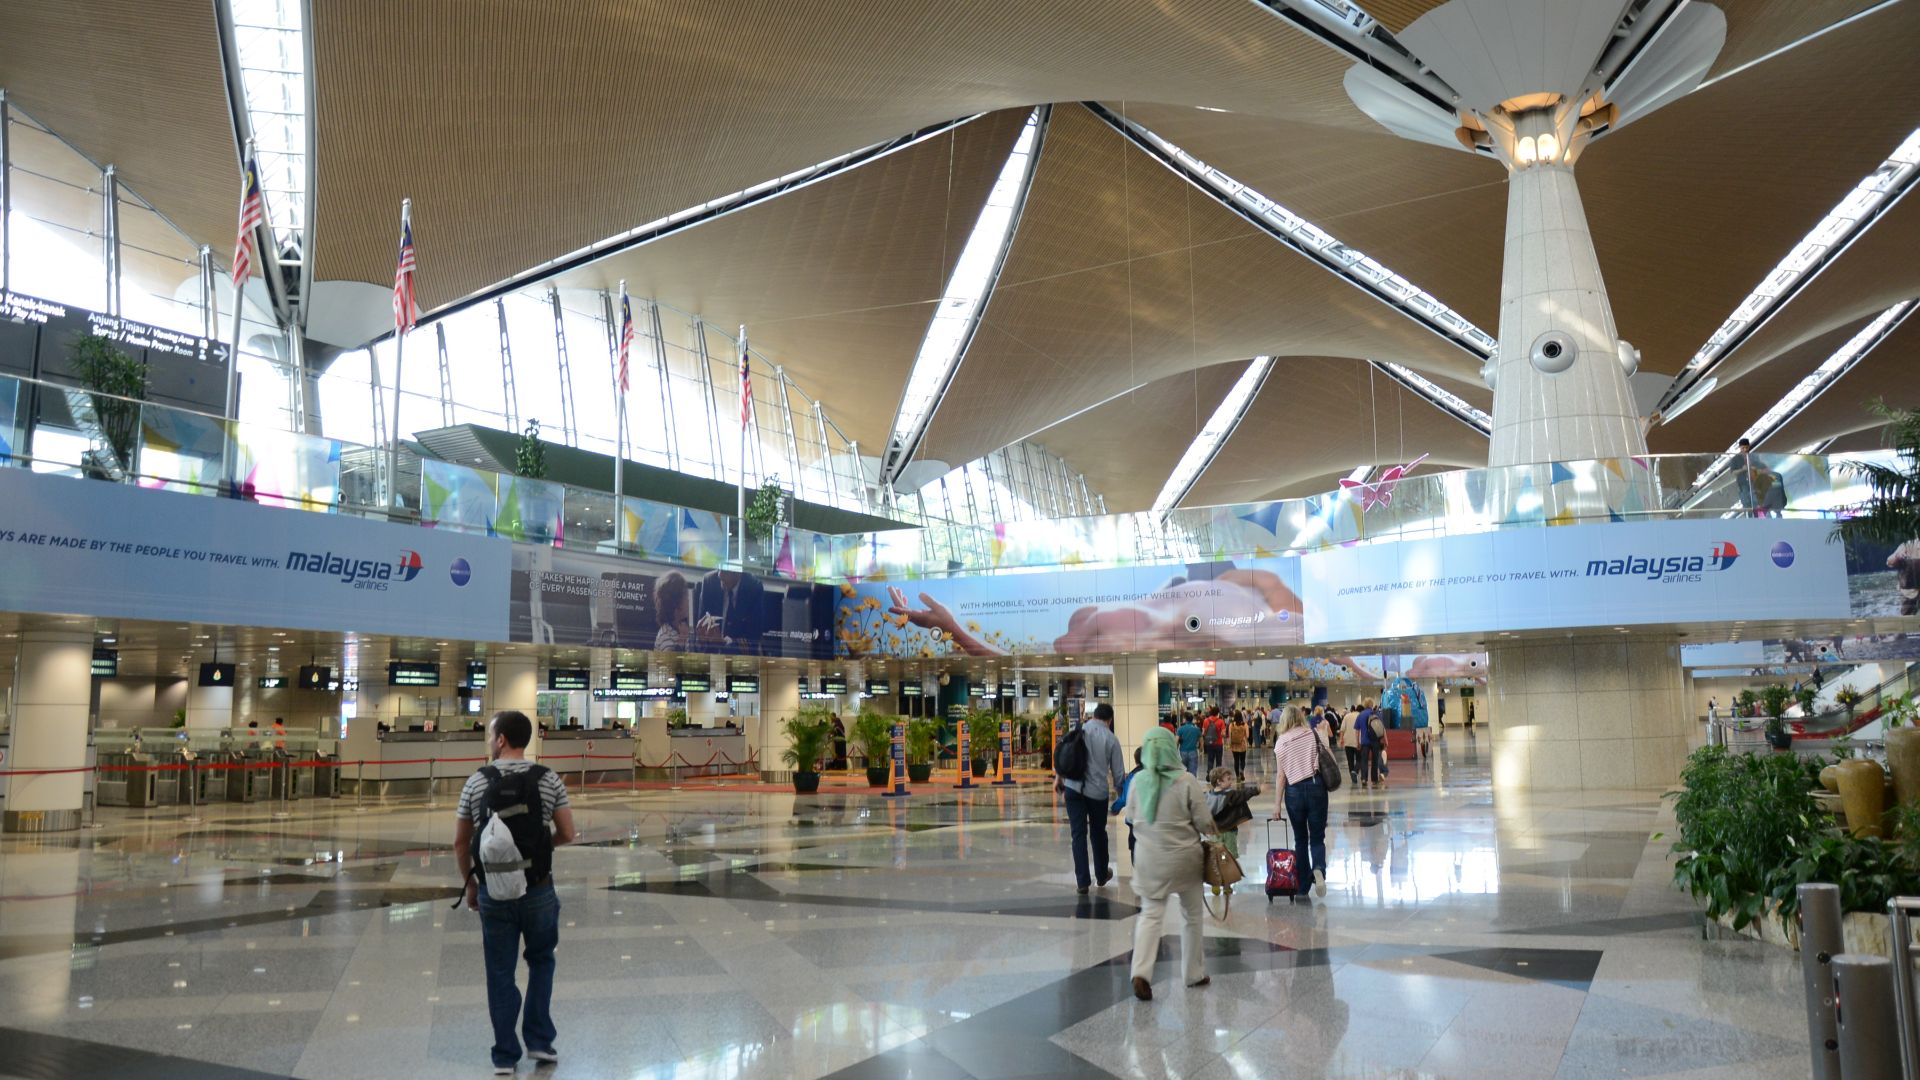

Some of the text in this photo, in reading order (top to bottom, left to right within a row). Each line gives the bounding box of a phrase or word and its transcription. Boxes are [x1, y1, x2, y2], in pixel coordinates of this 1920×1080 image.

[88, 312, 119, 330] Anjung
[119, 319, 146, 334] Tinjau
[151, 339, 174, 352] Prayer
[173, 345, 194, 357] Room
[18, 533, 47, 545] ARE
[49, 536, 88, 549] MADE
[89, 540, 108, 551] BY
[109, 542, 133, 553] THE
[135, 545, 180, 559] PEOPLE
[183, 550, 206, 560] YOU
[209, 552, 248, 566] TRAVEL
[251, 557, 280, 569] WITH.
[286, 551, 392, 583] malaysia
[1586, 555, 1704, 580] malaysia
[354, 579, 388, 591] airlines
[538, 572, 563, 583] MAKES
[565, 575, 575, 583] ME
[576, 577, 599, 586] HAPPY
[611, 579, 620, 588] BE
[628, 582, 645, 591] PART
[541, 582, 565, 593] EVERY
[1337, 584, 1371, 597] JOURNEYS
[1373, 583, 1389, 592] ARE
[1391, 581, 1413, 590] MADE
[1429, 578, 1446, 587] THE
[1447, 575, 1484, 585] PEOPLE
[1486, 573, 1507, 582] YOU
[1509, 571, 1547, 581] TRAVEL
[1550, 569, 1579, 578] WITH.
[1662, 574, 1702, 584] airlines
[960, 588, 1225, 610] WITH MHMOBILE, YOUR JOURNEYS BEGIN RIGHT WHERE YOU ARE.
[1209, 616, 1252, 627] malaysia
